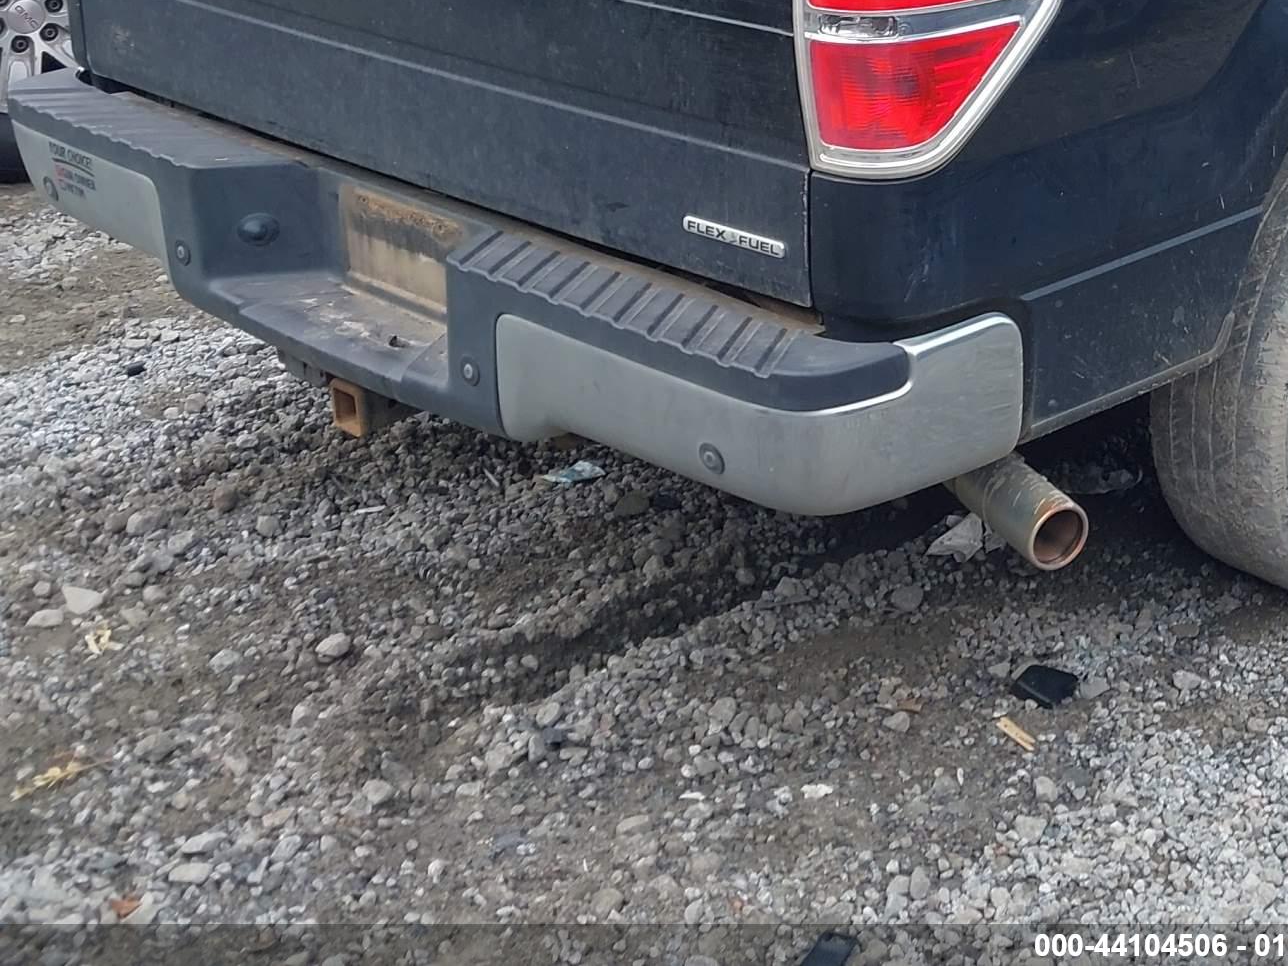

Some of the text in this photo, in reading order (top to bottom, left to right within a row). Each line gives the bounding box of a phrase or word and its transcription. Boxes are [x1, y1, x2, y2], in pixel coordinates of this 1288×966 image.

[14, 5, 39, 29] GMC
[687, 220, 780, 256] FLEX FUEL
